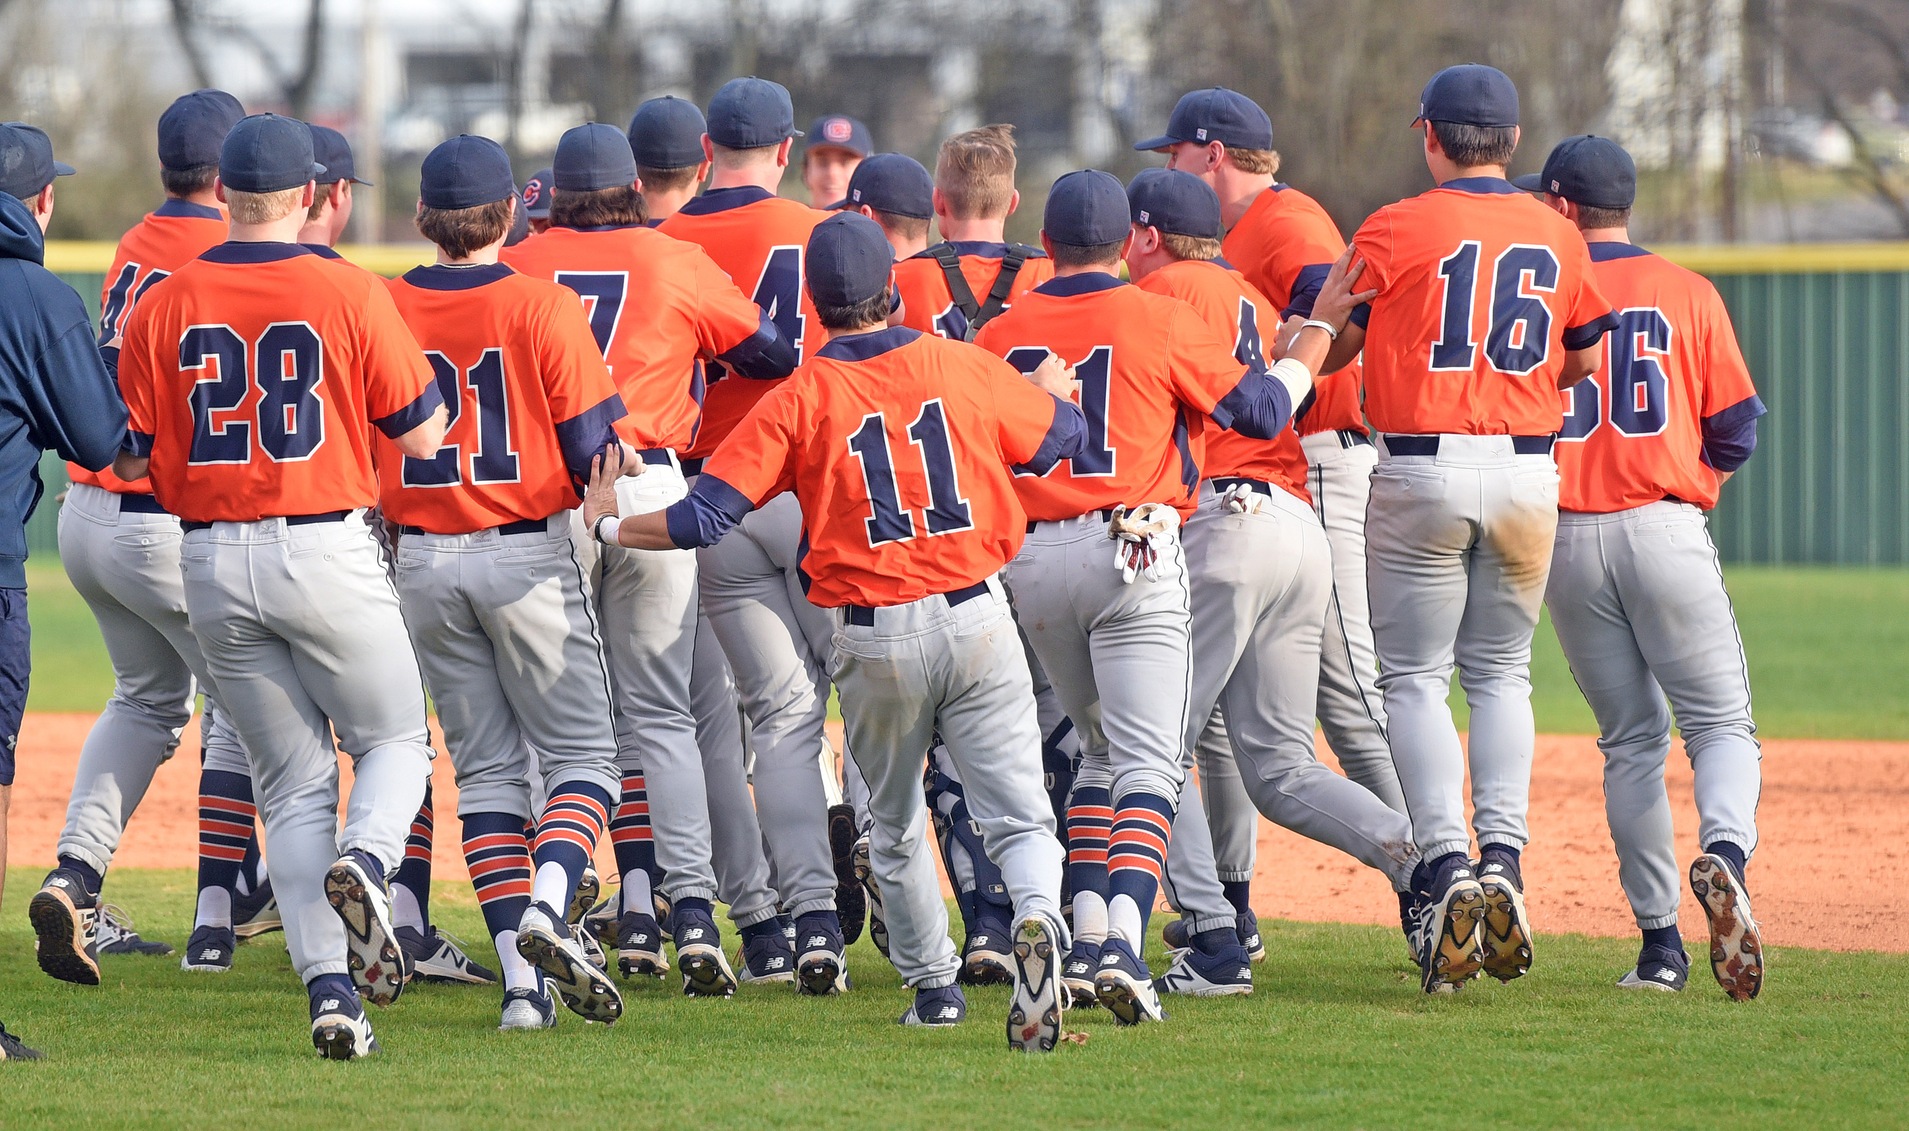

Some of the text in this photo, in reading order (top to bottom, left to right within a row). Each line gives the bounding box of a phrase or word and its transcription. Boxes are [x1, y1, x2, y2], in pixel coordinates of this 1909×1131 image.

[1428, 240, 1562, 377] 16
[177, 321, 325, 467] 28
[402, 346, 521, 489] 21
[846, 396, 976, 549] 11
[1451, 868, 1470, 880] NB
[1483, 863, 1504, 875] NB
[626, 932, 648, 945] NB
[684, 928, 704, 941] NB
[806, 935, 827, 949] NB
[199, 948, 222, 961] NB
[1100, 954, 1120, 968] NB
[765, 956, 785, 971] NB
[1067, 961, 1089, 974] NB
[1654, 967, 1678, 982] NB
[317, 999, 339, 1013] NB
[934, 1006, 959, 1019] NB
